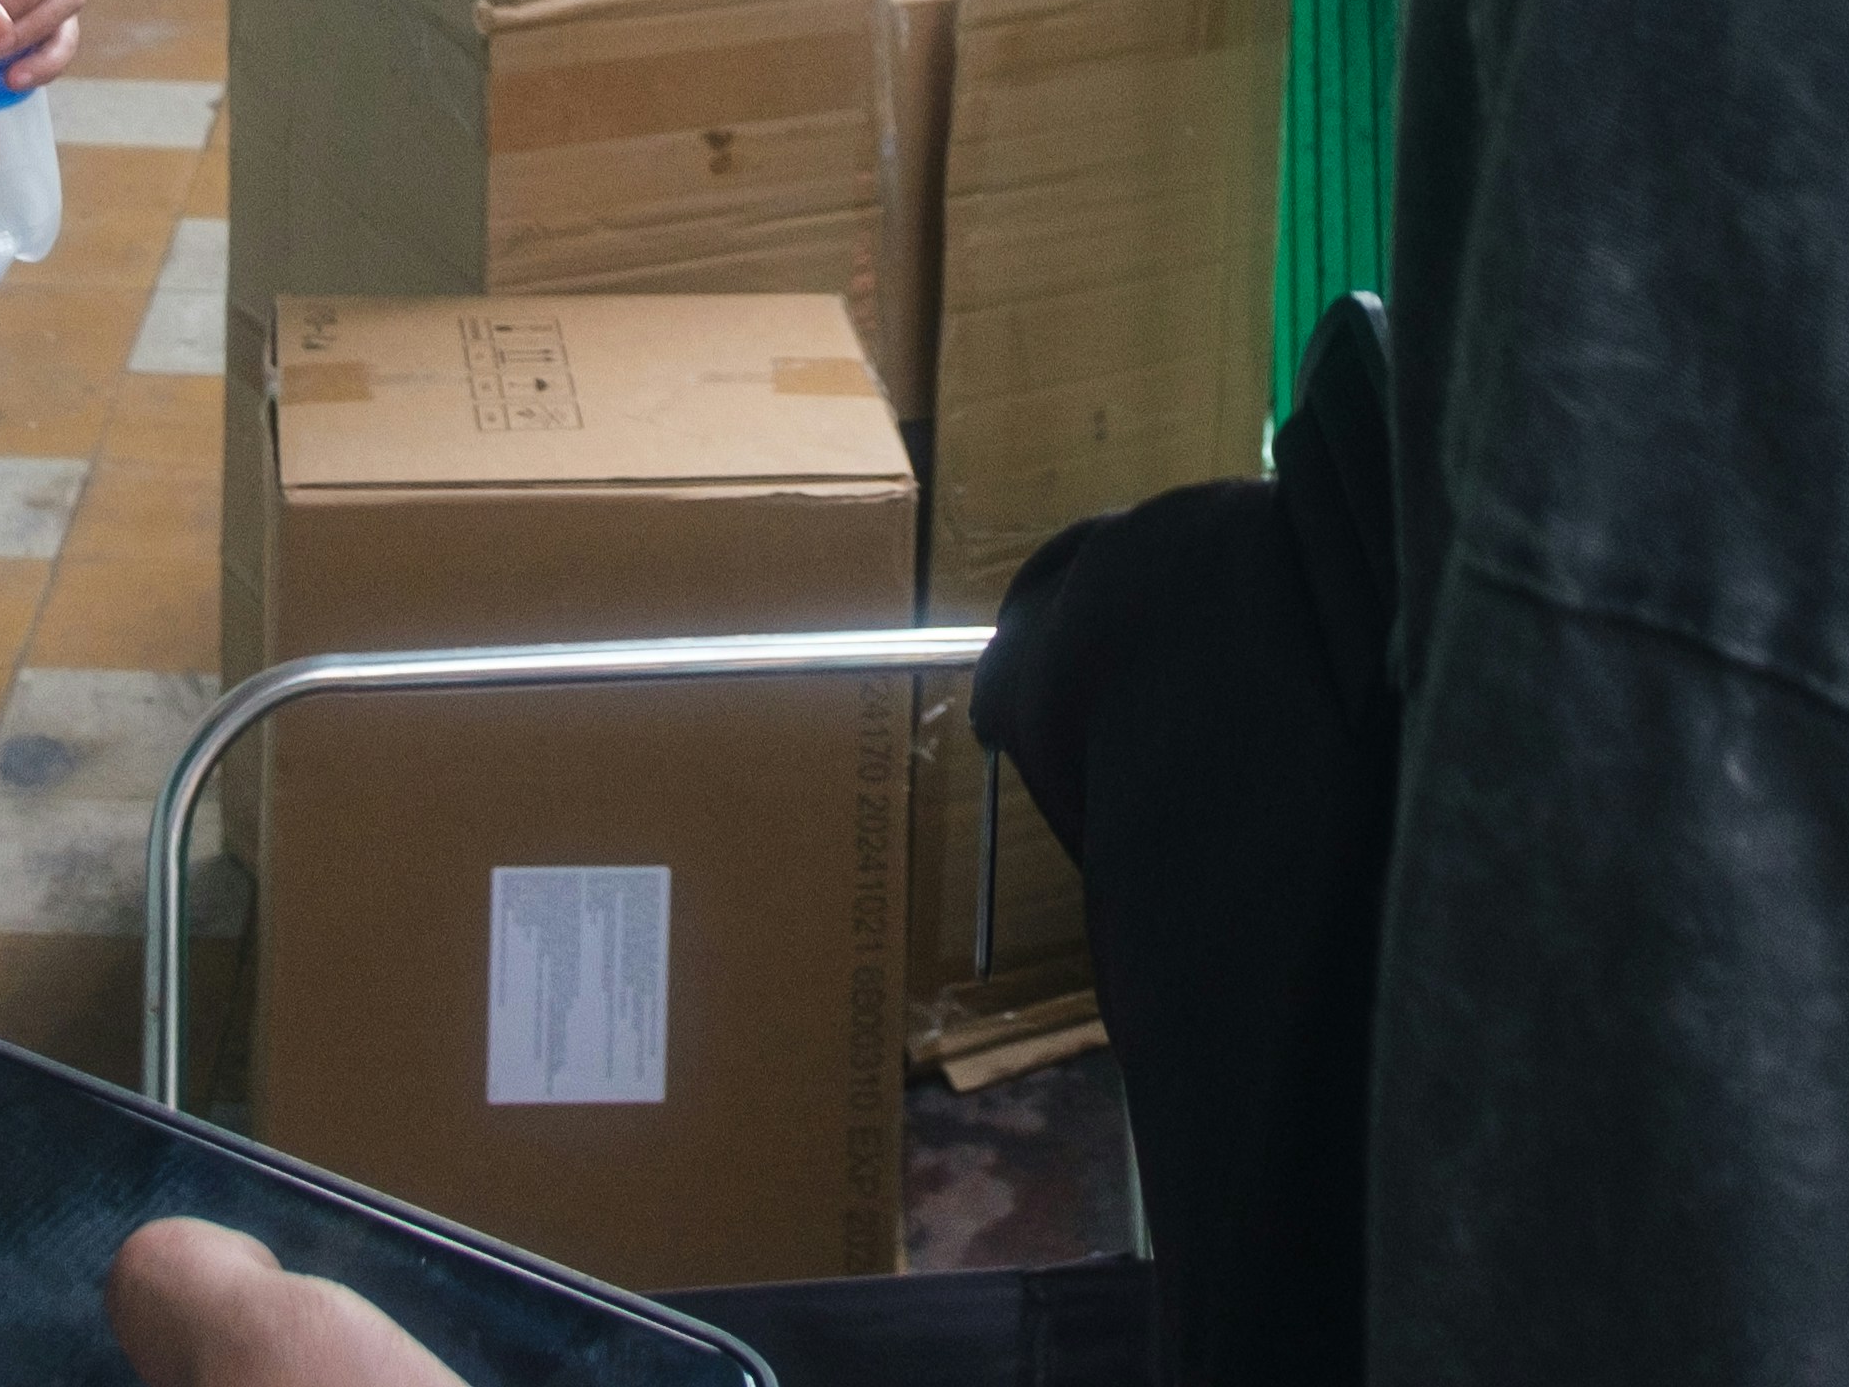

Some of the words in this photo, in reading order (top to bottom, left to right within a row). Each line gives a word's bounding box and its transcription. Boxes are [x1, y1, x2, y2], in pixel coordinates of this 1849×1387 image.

[855, 675, 893, 785] 24170
[852, 792, 891, 954] 20241021
[845, 1124, 886, 1199] EXP
